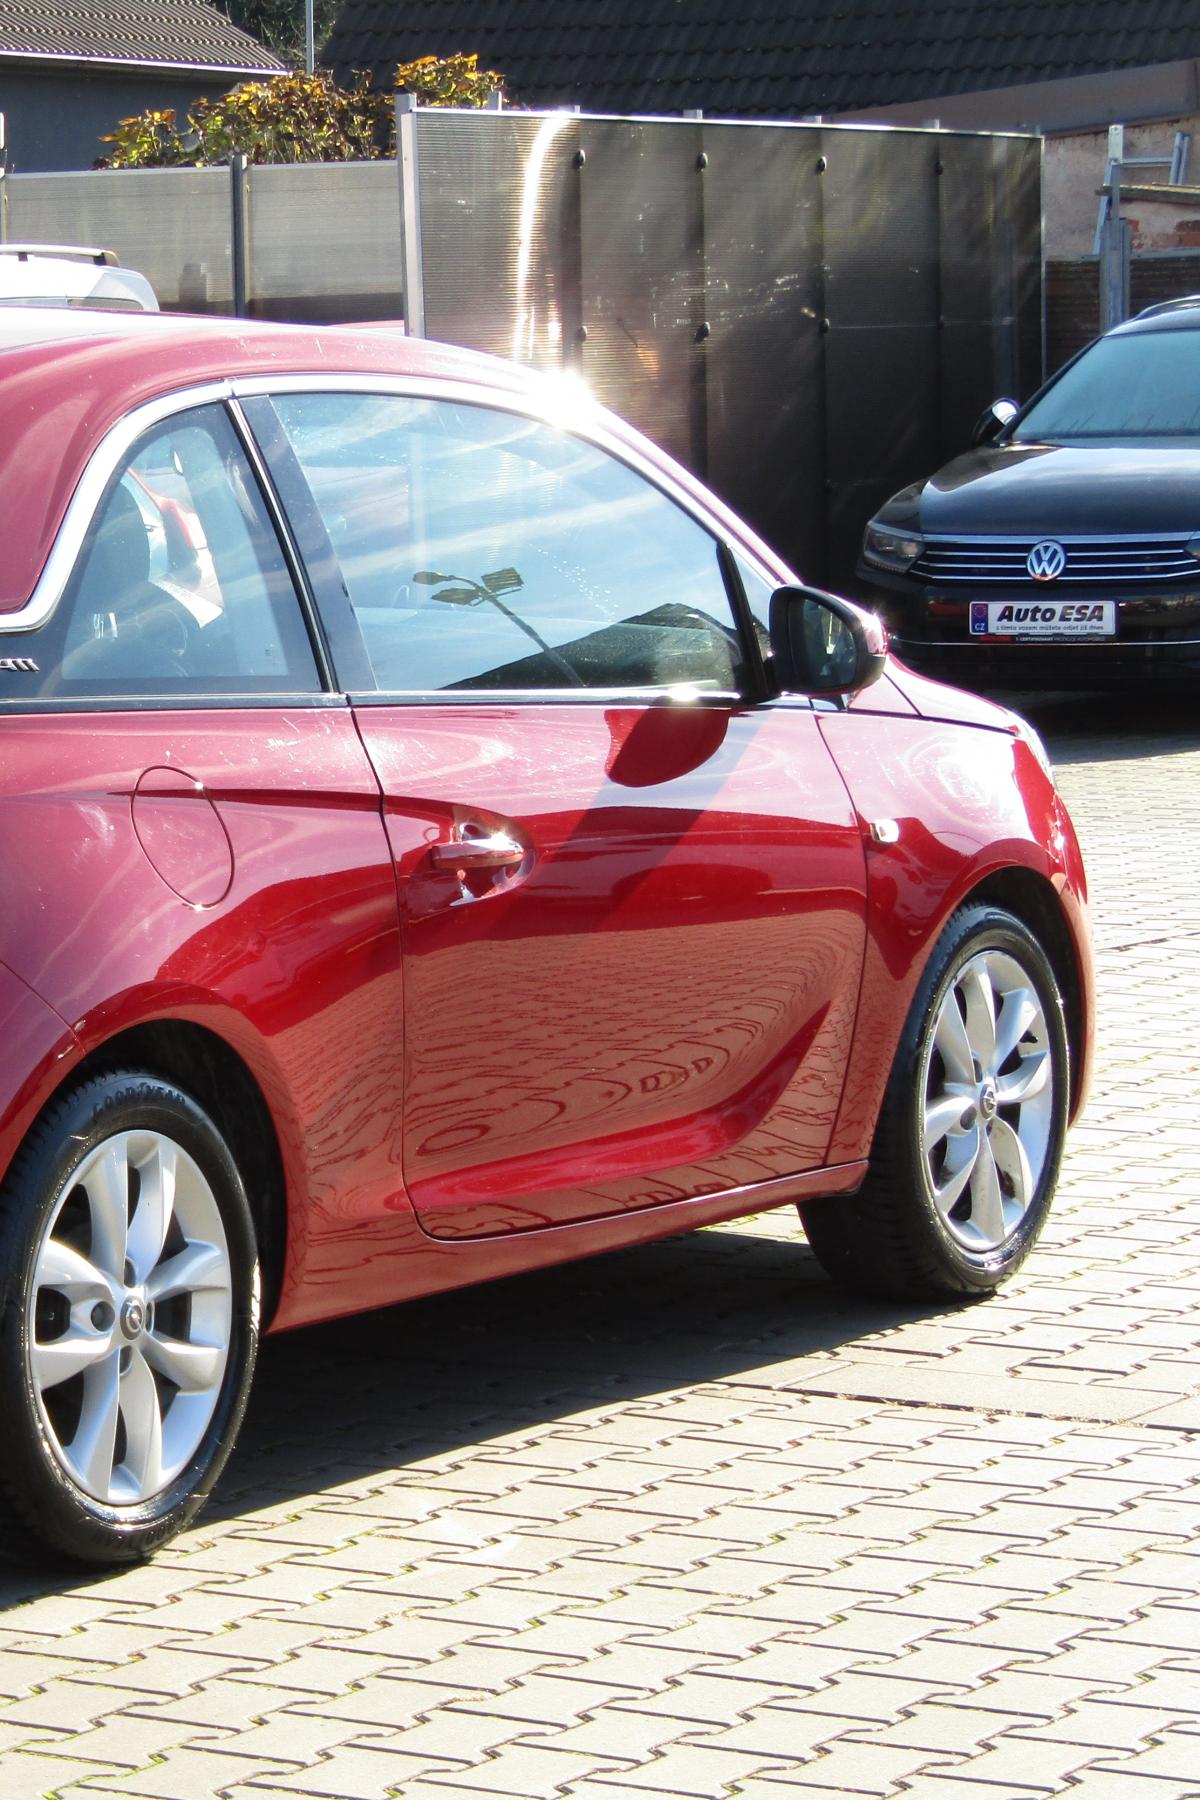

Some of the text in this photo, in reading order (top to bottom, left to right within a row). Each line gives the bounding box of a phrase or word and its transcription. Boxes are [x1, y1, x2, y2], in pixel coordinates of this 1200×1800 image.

[997, 604, 1104, 623] Auto ESA
[974, 622, 985, 631] CZ
[93, 1082, 187, 1117] GOODYEAR
